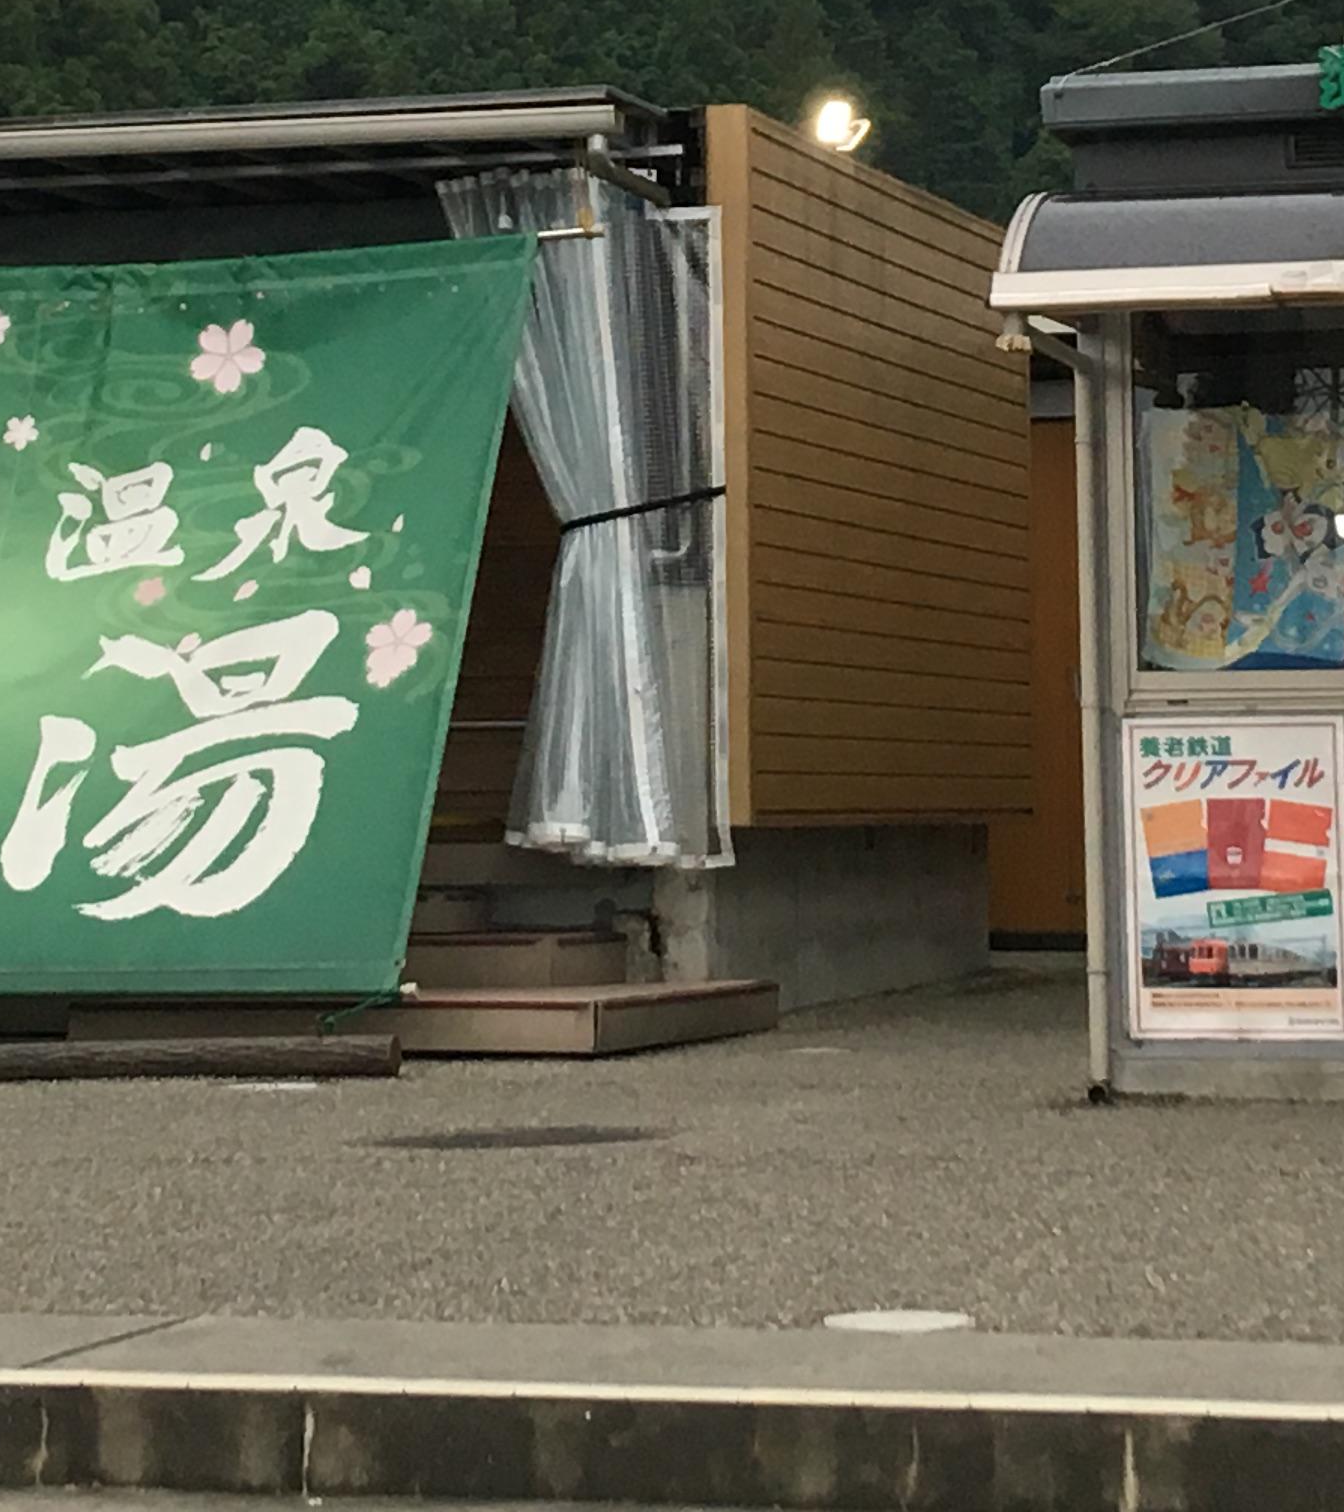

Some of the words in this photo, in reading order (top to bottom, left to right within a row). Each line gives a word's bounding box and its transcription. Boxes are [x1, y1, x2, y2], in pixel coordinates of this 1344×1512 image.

[1140, 735, 1232, 759] 養老鉄道
[1142, 757, 1325, 792] クリアファイル
